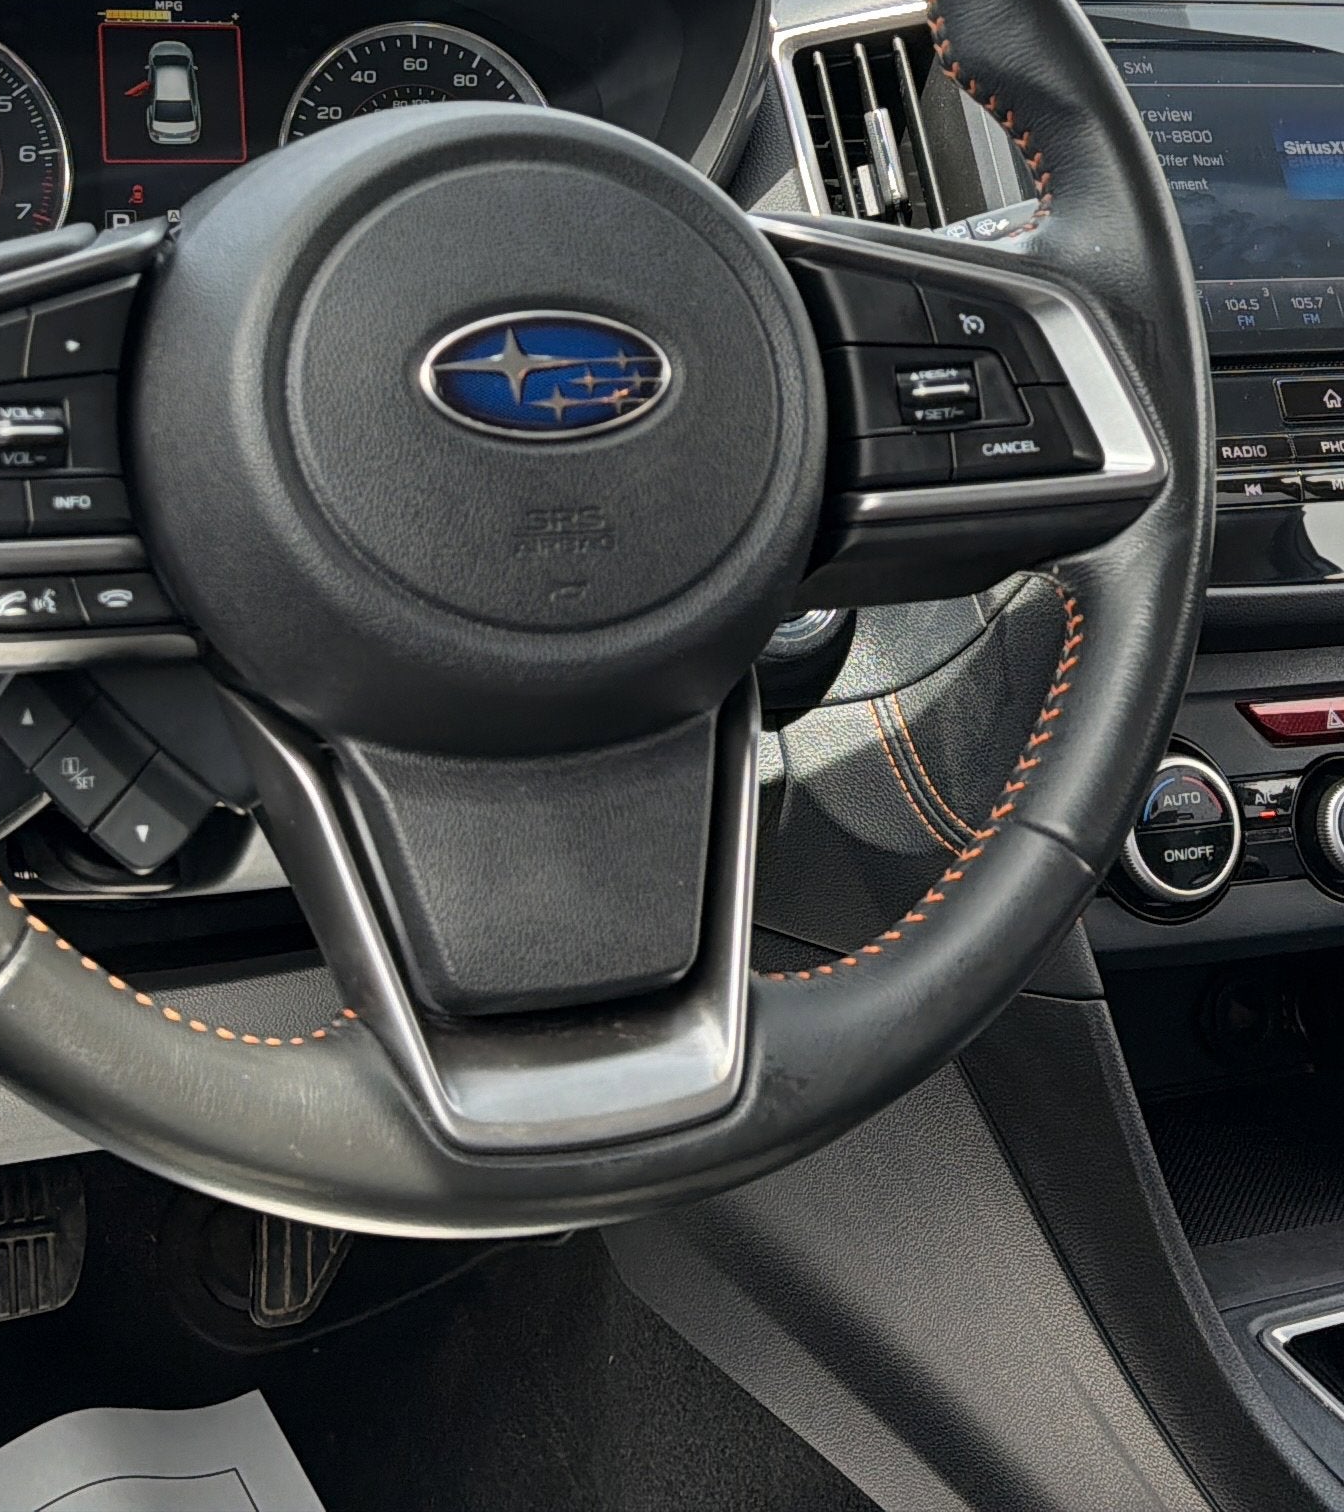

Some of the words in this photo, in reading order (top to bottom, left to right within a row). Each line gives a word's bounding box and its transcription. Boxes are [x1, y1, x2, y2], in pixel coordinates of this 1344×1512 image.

[154, 1, 183, 12] MPG
[402, 57, 428, 72] 60
[1123, 62, 1154, 75] SXM
[351, 69, 377, 84] 40
[452, 73, 478, 87] 80
[316, 105, 343, 120] 20
[1140, 107, 1193, 122] review
[18, 144, 38, 164] 6
[1193, 153, 1225, 167] Now!
[13, 203, 33, 221] 7
[1224, 297, 1260, 311] 104.5
[1290, 296, 1323, 310] 105.7
[1237, 314, 1256, 327] FM
[1302, 313, 1321, 325] FM
[982, 440, 1041, 456] CANCEL
[1221, 444, 1268, 459] RADIO
[52, 494, 91, 509] INFO
[1163, 791, 1201, 807] AUTO
[1255, 792, 1277, 805] A/C
[1164, 845, 1214, 863] ON/OFF
